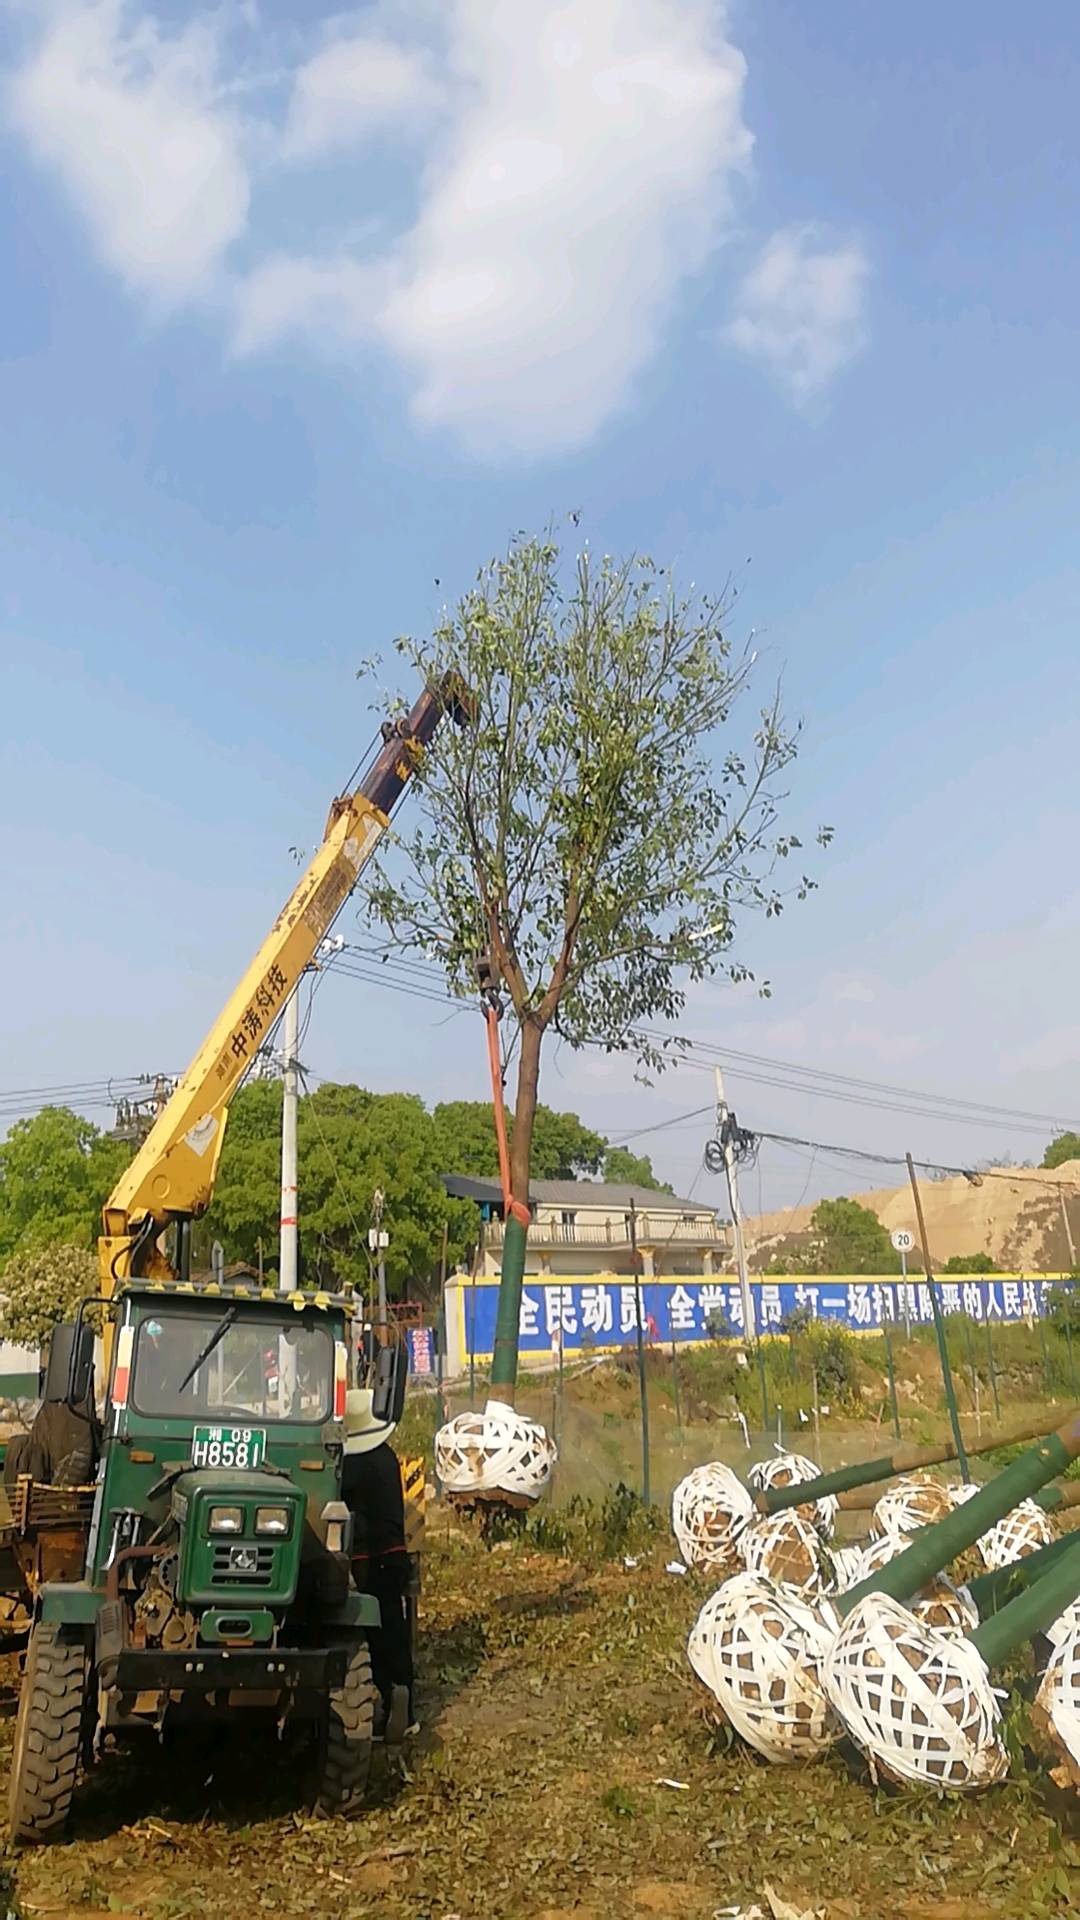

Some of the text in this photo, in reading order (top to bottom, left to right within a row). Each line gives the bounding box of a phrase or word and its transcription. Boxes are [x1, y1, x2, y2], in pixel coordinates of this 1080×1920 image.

[231, 963, 288, 1058] 中涛科技
[898, 1234, 910, 1246] 20
[518, 1284, 649, 1336] 全民动员
[231, 1429, 252, 1443] 09
[193, 1440, 259, 1468] H8581
